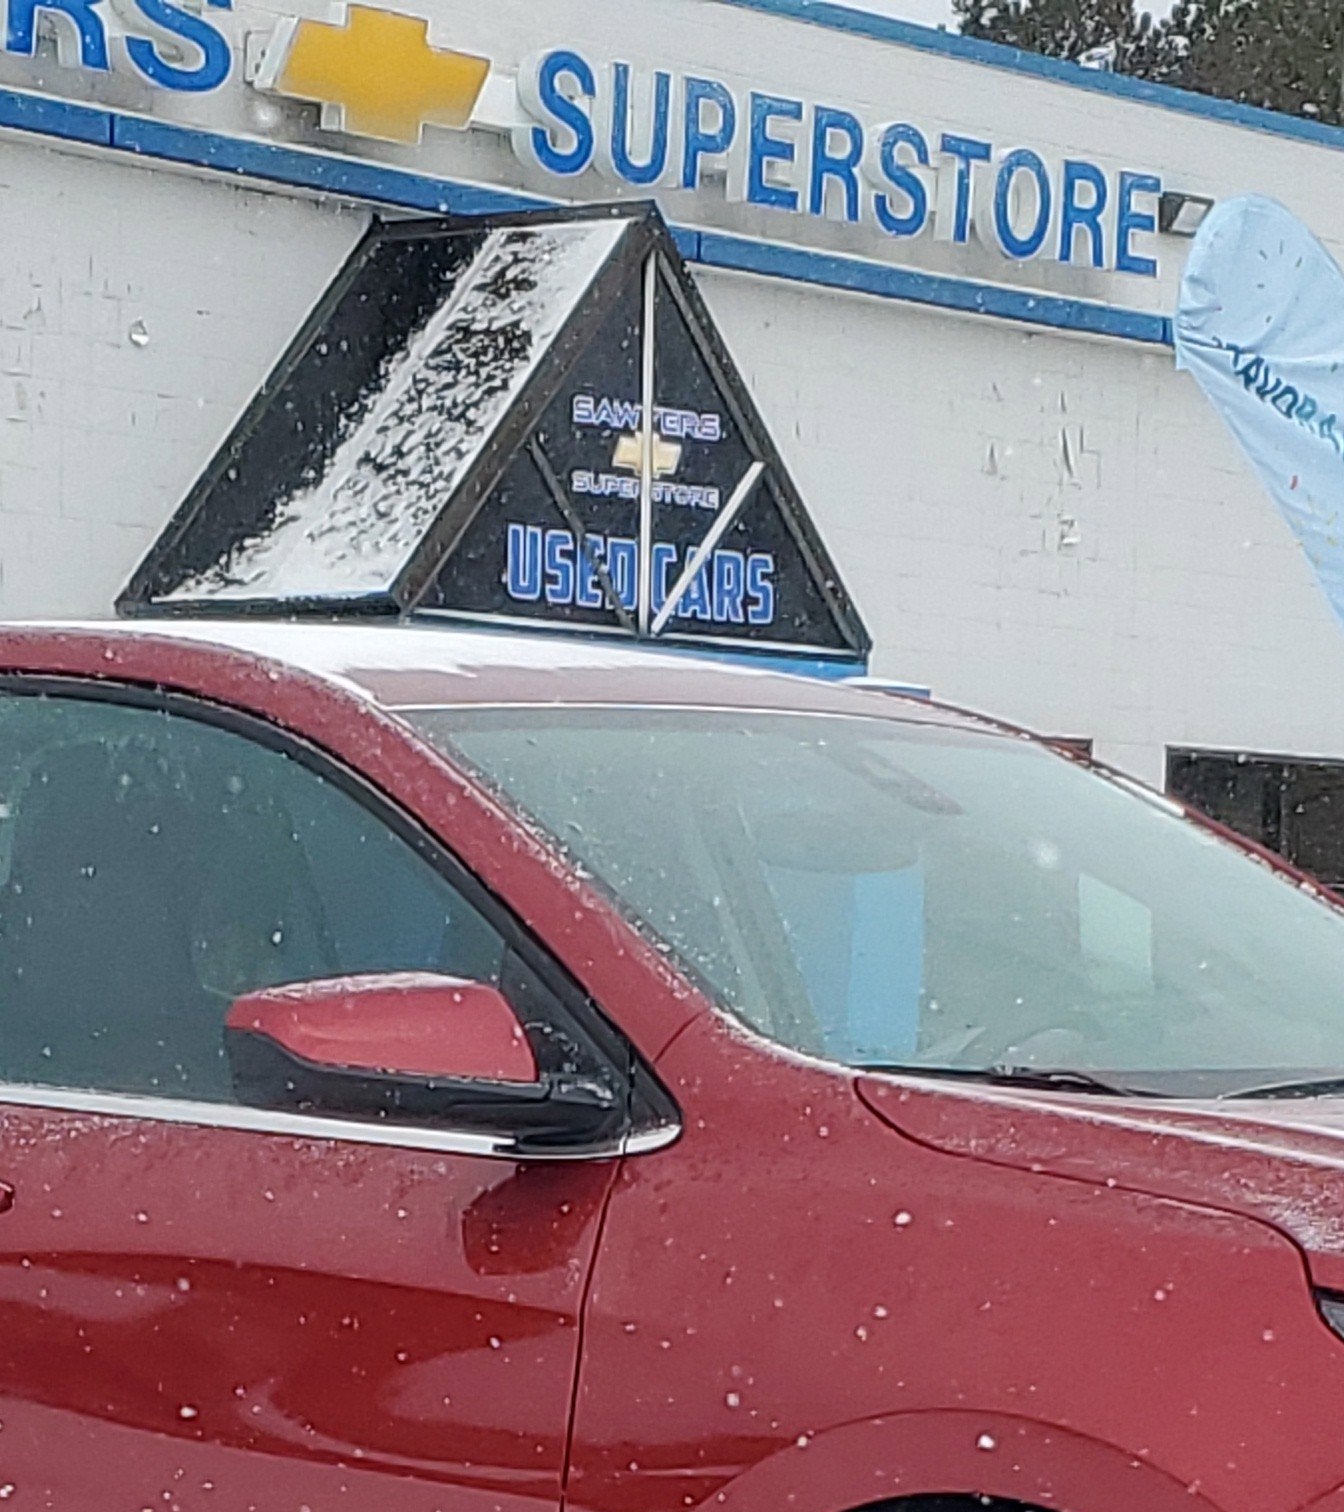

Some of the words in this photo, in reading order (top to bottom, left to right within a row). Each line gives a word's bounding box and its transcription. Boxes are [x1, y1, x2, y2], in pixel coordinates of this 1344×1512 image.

[530, 49, 1161, 278] SUPERSTORE
[506, 523, 639, 611] USED
[650, 542, 775, 625] CARS
